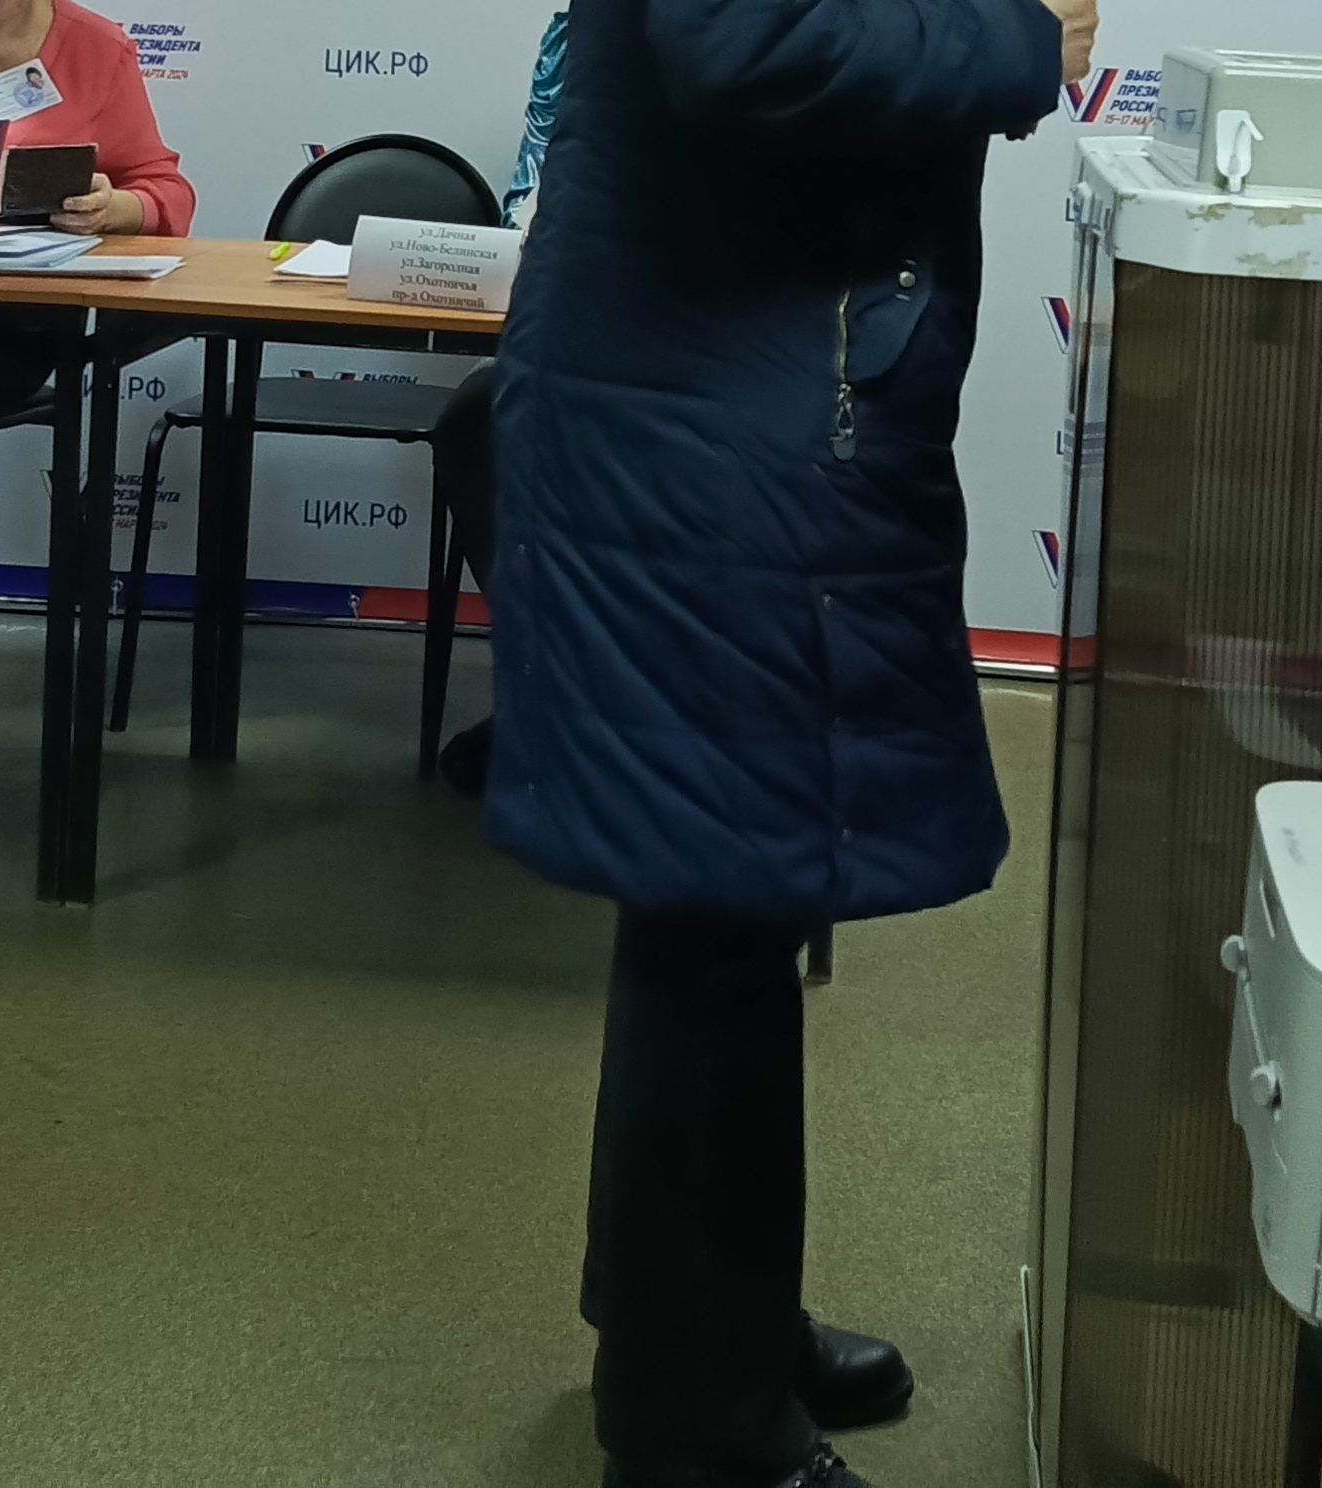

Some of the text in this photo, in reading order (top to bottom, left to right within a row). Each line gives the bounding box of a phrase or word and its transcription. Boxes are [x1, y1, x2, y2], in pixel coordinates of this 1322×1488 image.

[129, 23, 185, 36] ВЫБОРЫ
[134, 39, 201, 53] РЕЗИДЕНТА
[325, 48, 429, 77] ЦИК.РФ
[1109, 100, 1155, 113] РОССИ
[303, 499, 407, 529] ЦИК.РФ
